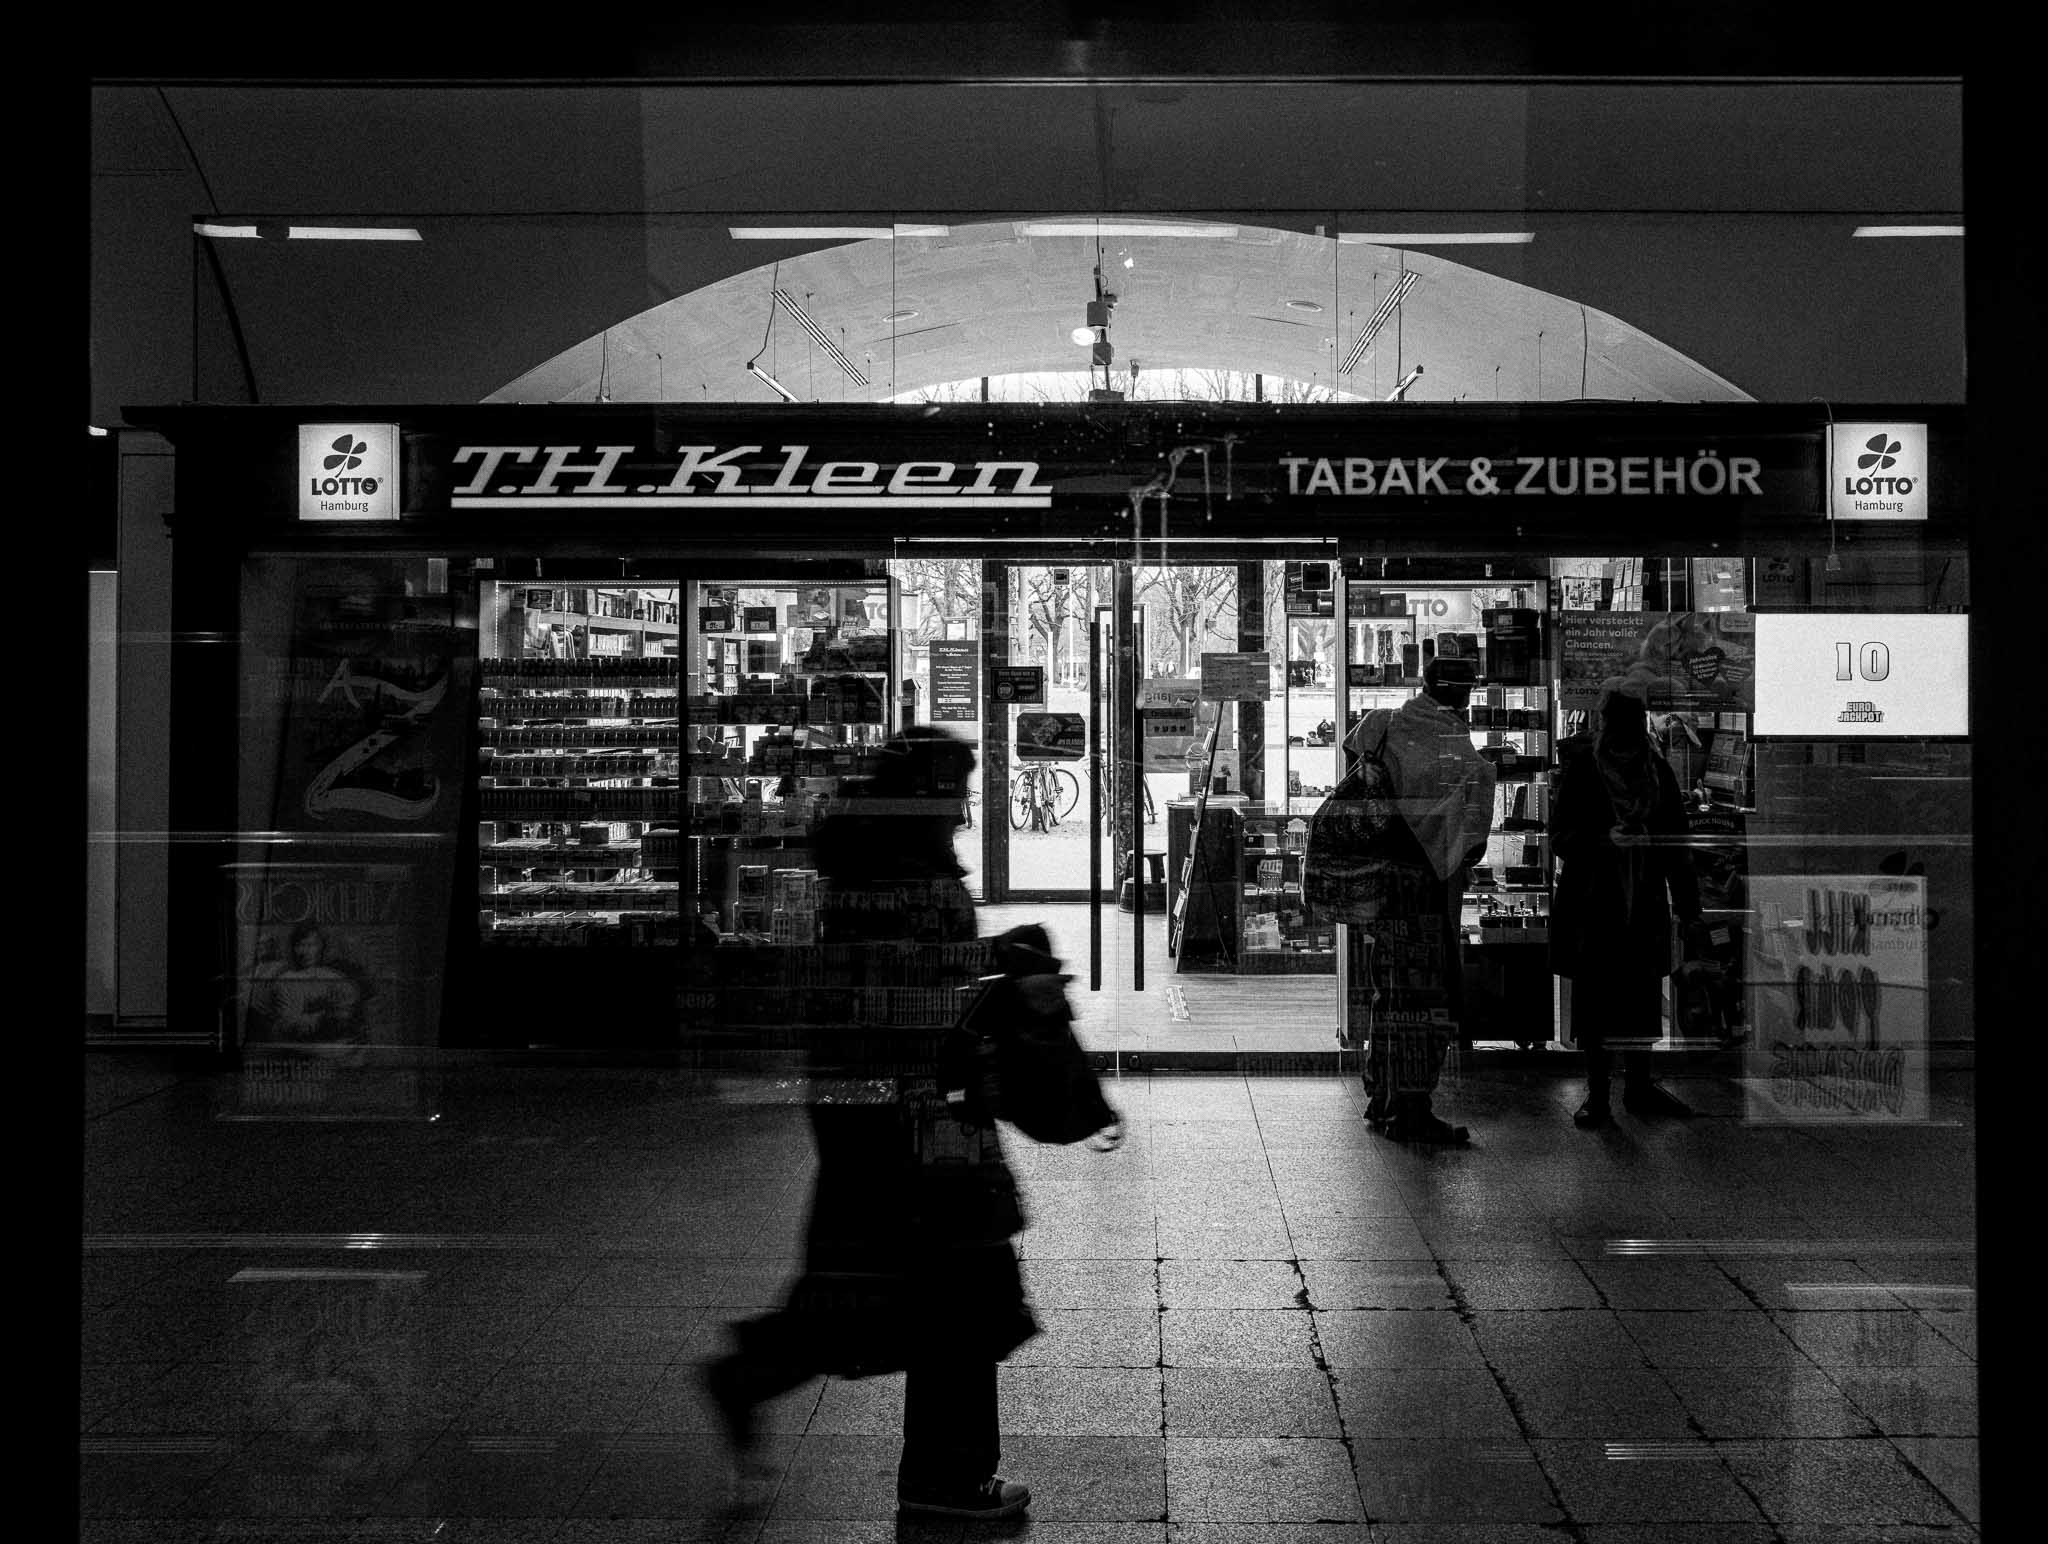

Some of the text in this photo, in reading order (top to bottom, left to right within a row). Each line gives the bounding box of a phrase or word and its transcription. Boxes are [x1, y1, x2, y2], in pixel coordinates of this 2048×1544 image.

[1280, 449, 1763, 496] TABAK & ZUBEHÖR
[311, 477, 379, 496] LOTTO
[1845, 476, 1914, 496] LOTTO
[320, 500, 369, 513] Hamburg
[1855, 499, 1904, 513] Hamburg
[1565, 615, 1587, 625] Hier
[1565, 627, 1639, 637] ein Jahr voller
[1835, 641, 1890, 682] 10
[1846, 701, 1874, 712] EURO
[1837, 711, 1884, 723] JACKPOT
